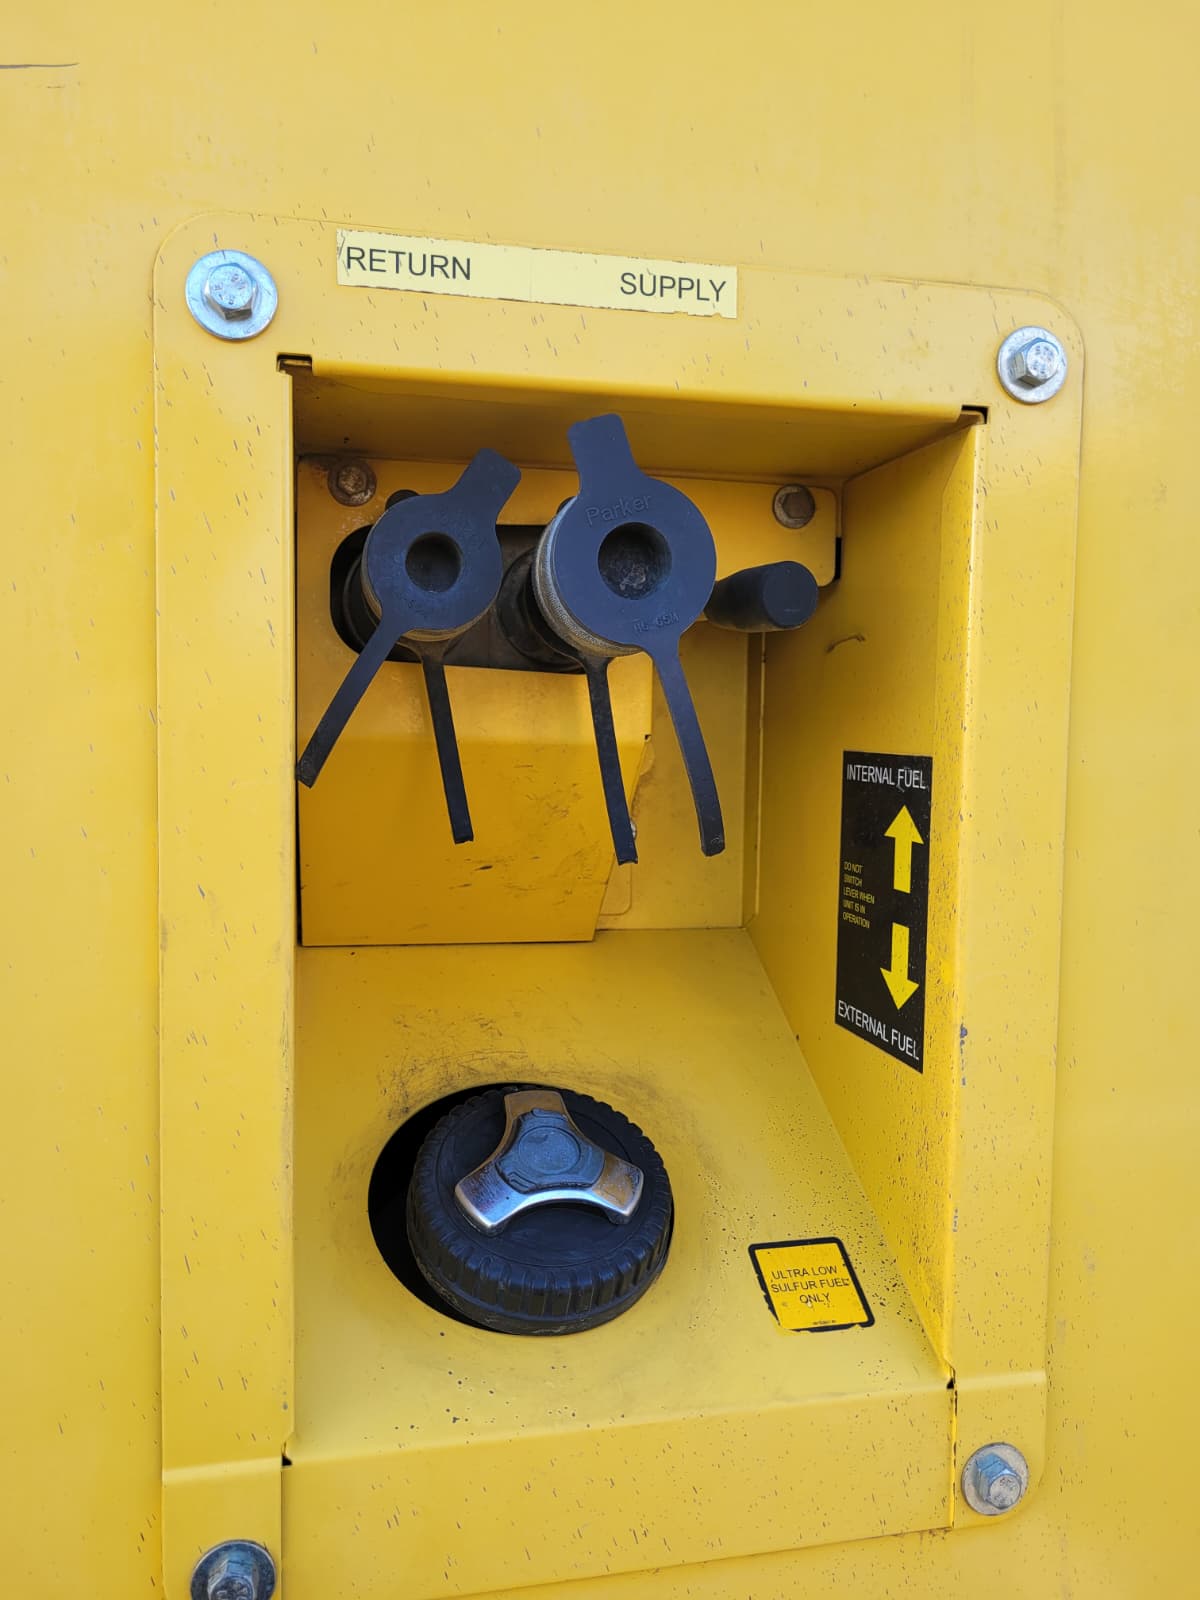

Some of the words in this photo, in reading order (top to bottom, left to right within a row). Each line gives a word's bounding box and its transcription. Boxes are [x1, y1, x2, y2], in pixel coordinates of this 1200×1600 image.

[346, 246, 471, 280] RETURN
[620, 272, 727, 302] SUPPLY
[585, 495, 651, 525] Parker
[847, 764, 894, 785] INTERNAL
[897, 768, 926, 788] FUEL
[843, 861, 852, 871] DO
[852, 863, 862, 873] NOT
[843, 886, 858, 898] LEVER
[859, 891, 874, 903] WHEN
[854, 903, 860, 912] IS
[843, 912, 869, 927] OPERATION
[838, 1000, 889, 1042] EXTERNAL
[891, 1028, 920, 1061] FUEL
[772, 1268, 809, 1279] ULTRA
[811, 1265, 838, 1276] LOW
[770, 1280, 818, 1293] SULFUR
[819, 1277, 850, 1289] FUEL
[799, 1292, 830, 1304] ONLY
